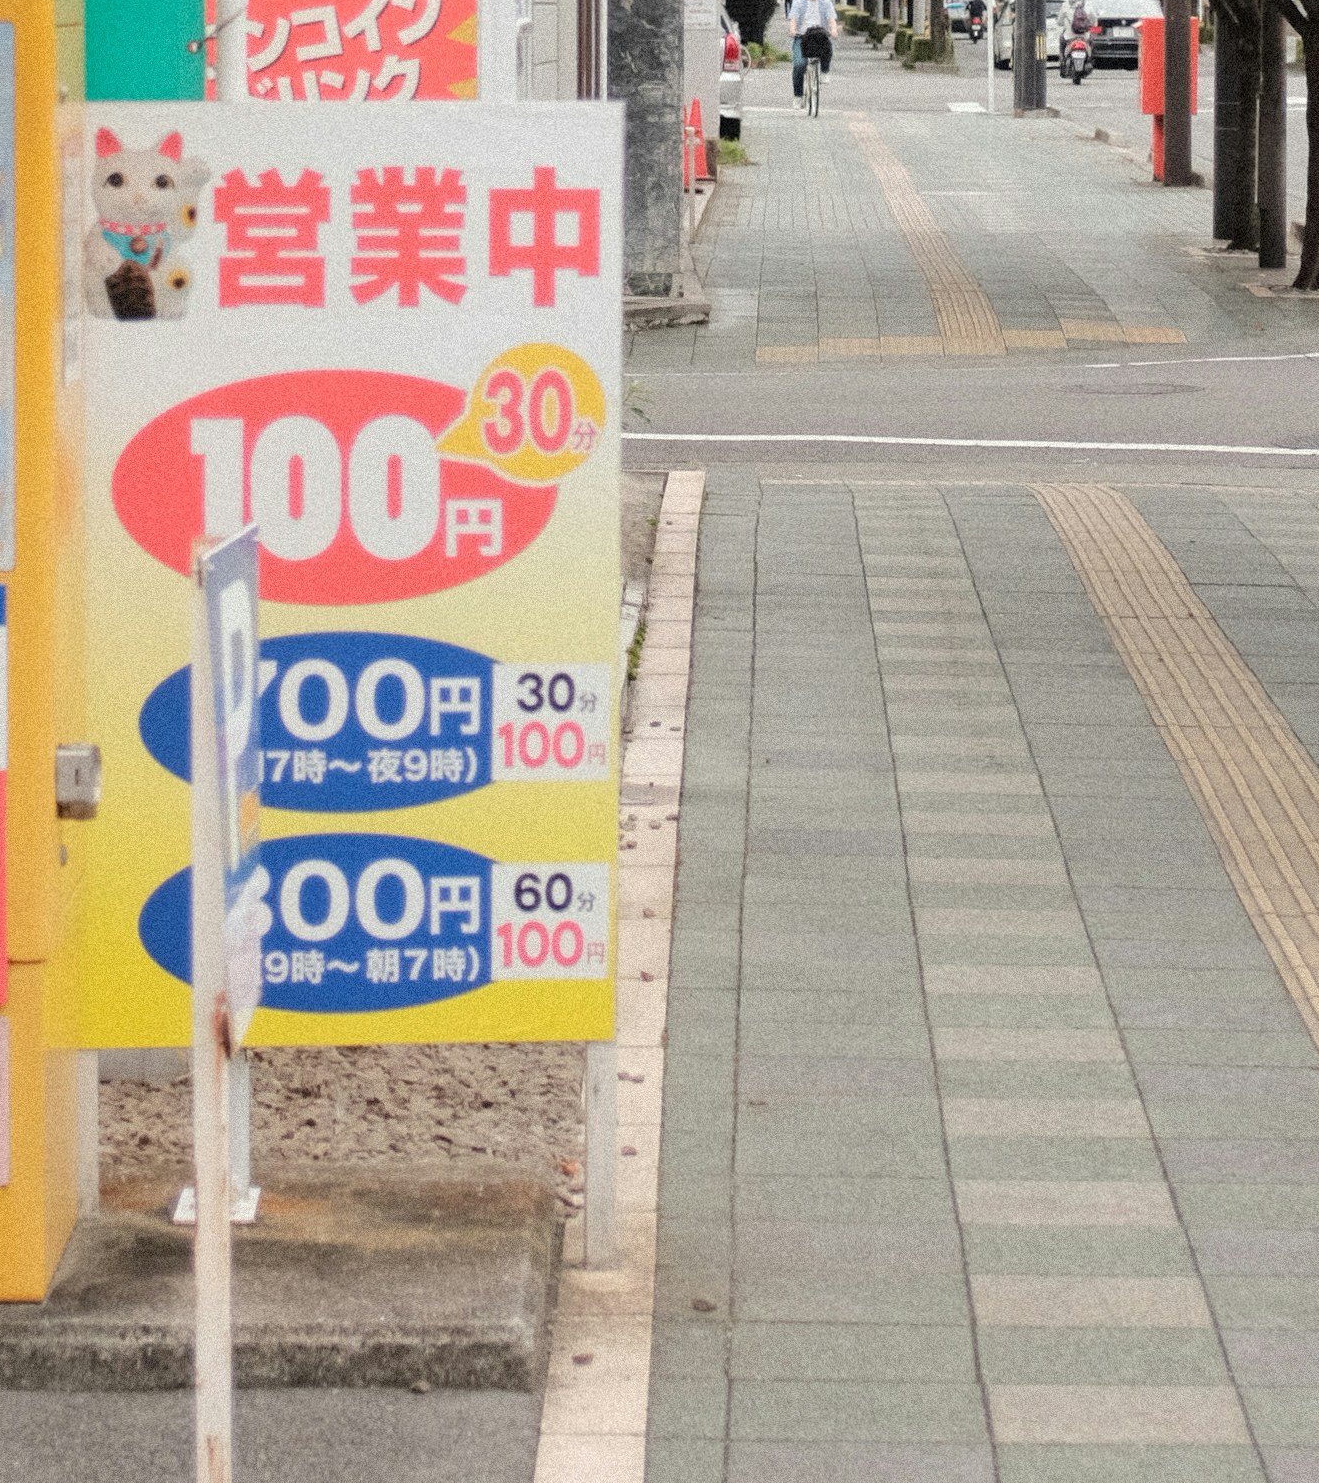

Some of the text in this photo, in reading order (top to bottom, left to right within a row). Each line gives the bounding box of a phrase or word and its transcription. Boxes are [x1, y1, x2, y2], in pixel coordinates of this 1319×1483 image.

[213, 166, 600, 309] 営業中
[484, 369, 597, 454] 30分
[190, 414, 503, 561] 100円
[516, 672, 597, 714] 30分
[259, 748, 478, 784] 7時〜夜9時)
[498, 721, 607, 769] 100円
[259, 857, 597, 941] 00円 60分
[259, 948, 479, 983] 9時〜朝7時)
[497, 920, 606, 968] 100円
